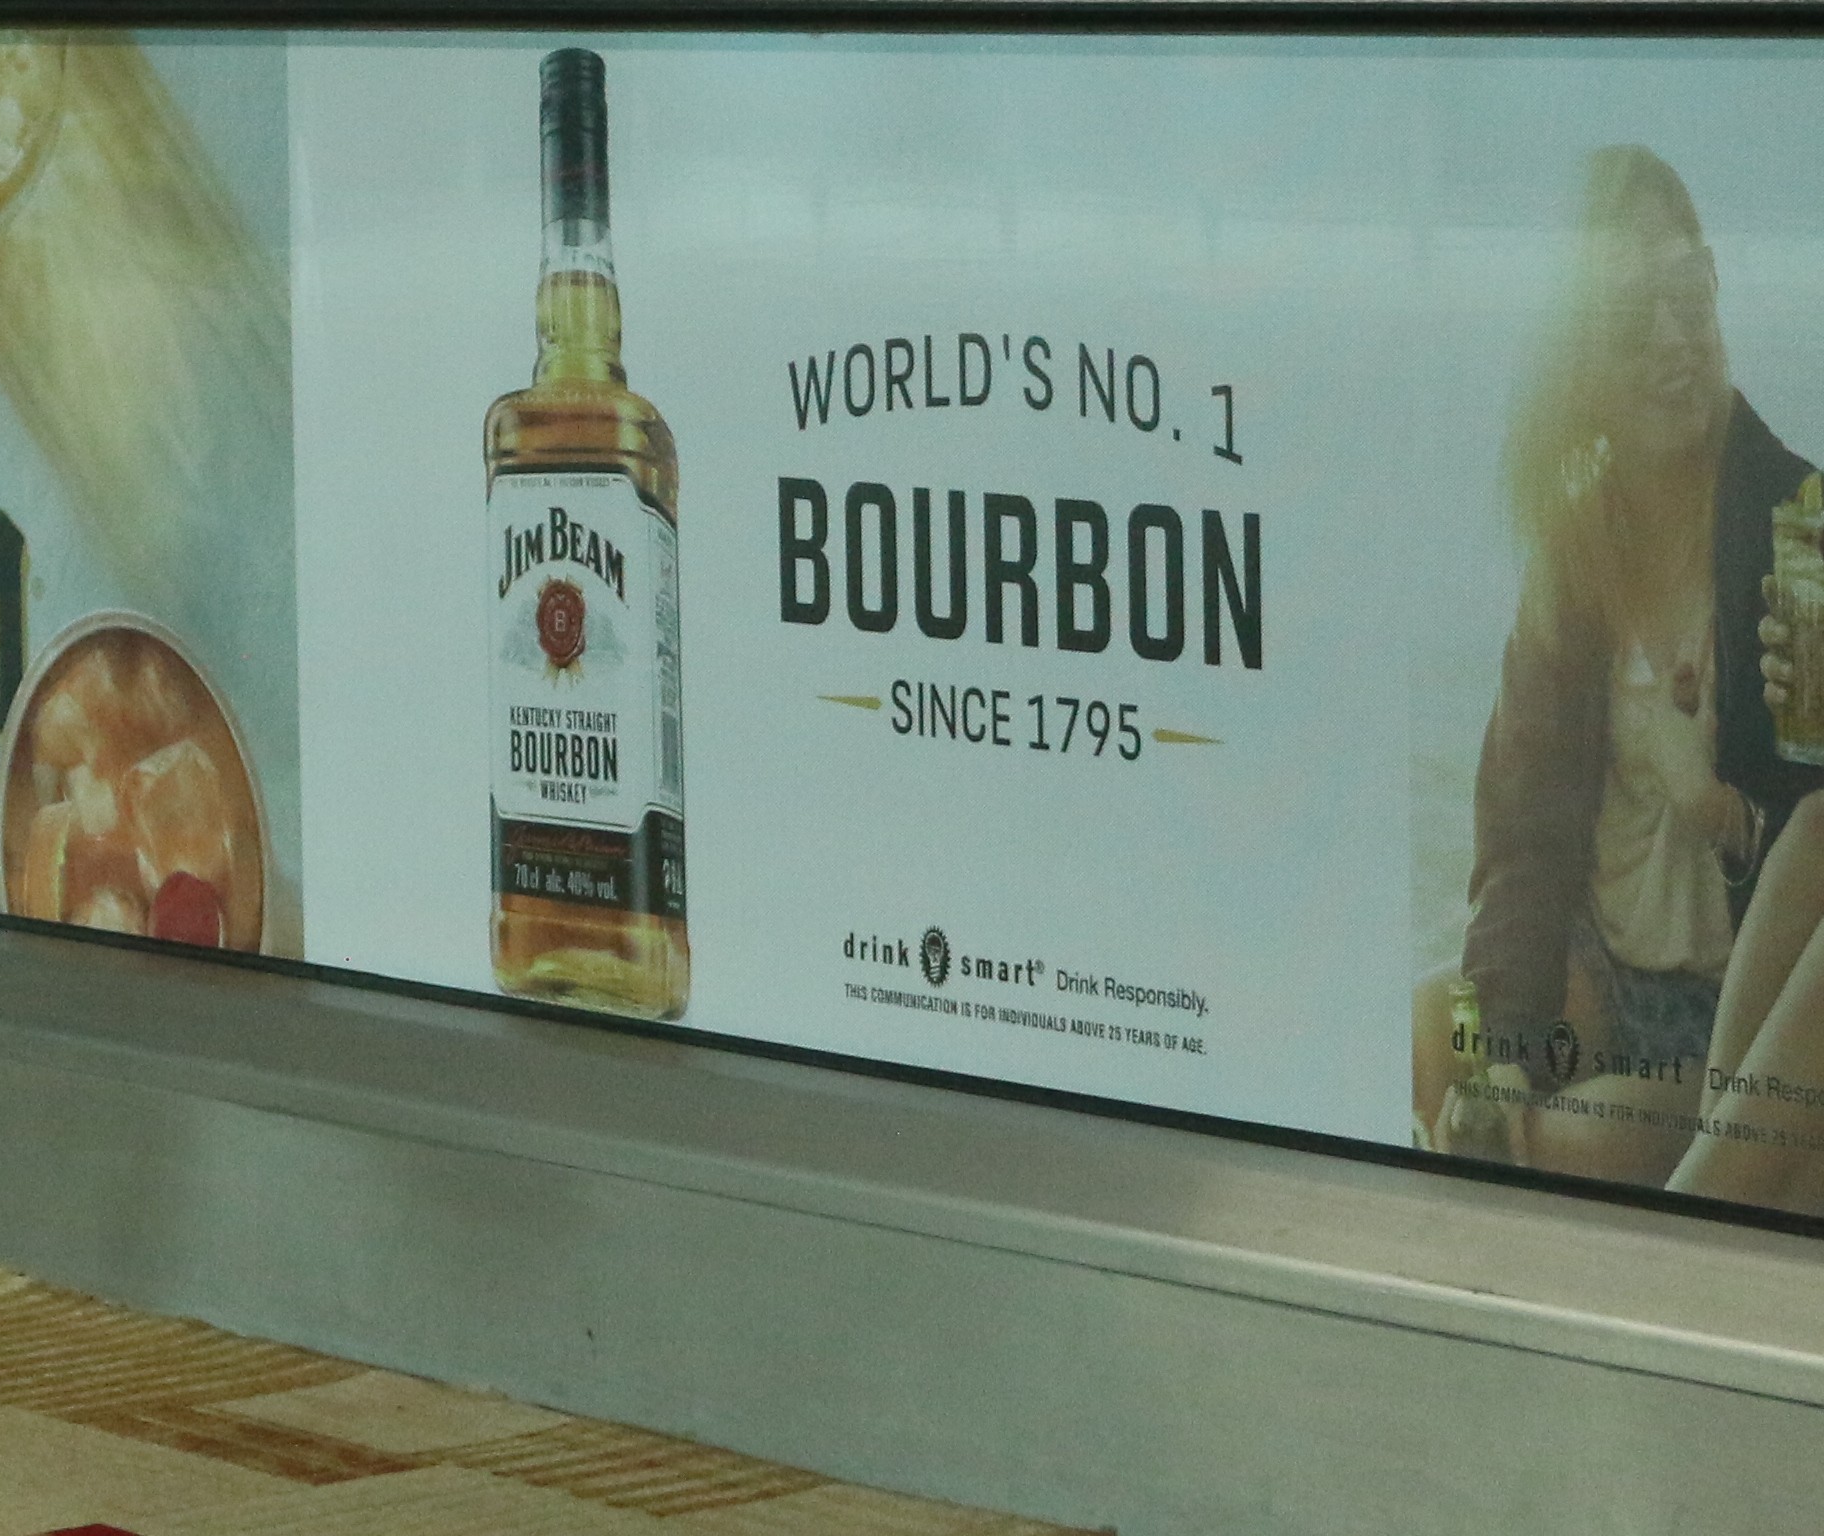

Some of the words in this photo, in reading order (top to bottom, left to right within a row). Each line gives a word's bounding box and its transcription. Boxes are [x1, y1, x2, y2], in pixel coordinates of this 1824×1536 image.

[788, 332, 1054, 432] WORLD'S
[1078, 341, 1181, 442] NO.
[1210, 384, 1244, 466] 1
[497, 523, 545, 600] JIM
[549, 505, 626, 602] BEAM
[777, 475, 1264, 672] BOURBON
[510, 706, 561, 728] KENTUCKY
[566, 711, 617, 733] STRAIGHT
[510, 729, 618, 783] BOURBON
[890, 678, 1012, 748] SINCE
[1026, 694, 1143, 762] 1795
[539, 779, 587, 805] WHISKEY
[567, 868, 594, 898] 40%
[596, 874, 619, 901] vol.
[844, 932, 909, 968] drink
[1057, 969, 1099, 997] Drink
[1104, 976, 1209, 1019] Responsibly.
[845, 983, 867, 1002] THIS
[870, 986, 958, 1016] COMMUNICATION
[960, 1000, 972, 1018] IS
[975, 1002, 996, 1022] FOR
[998, 1007, 1066, 1033] INDIVIDUALS
[1070, 1016, 1105, 1040] ABOVE
[1108, 1024, 1122, 1041] 25
[1125, 1027, 1161, 1049] YEARS
[1163, 1033, 1178, 1051] OF
[1181, 1036, 1207, 1056] AGE.
[1451, 1021, 1529, 1061] drink
[1709, 1067, 1760, 1098] Drink
